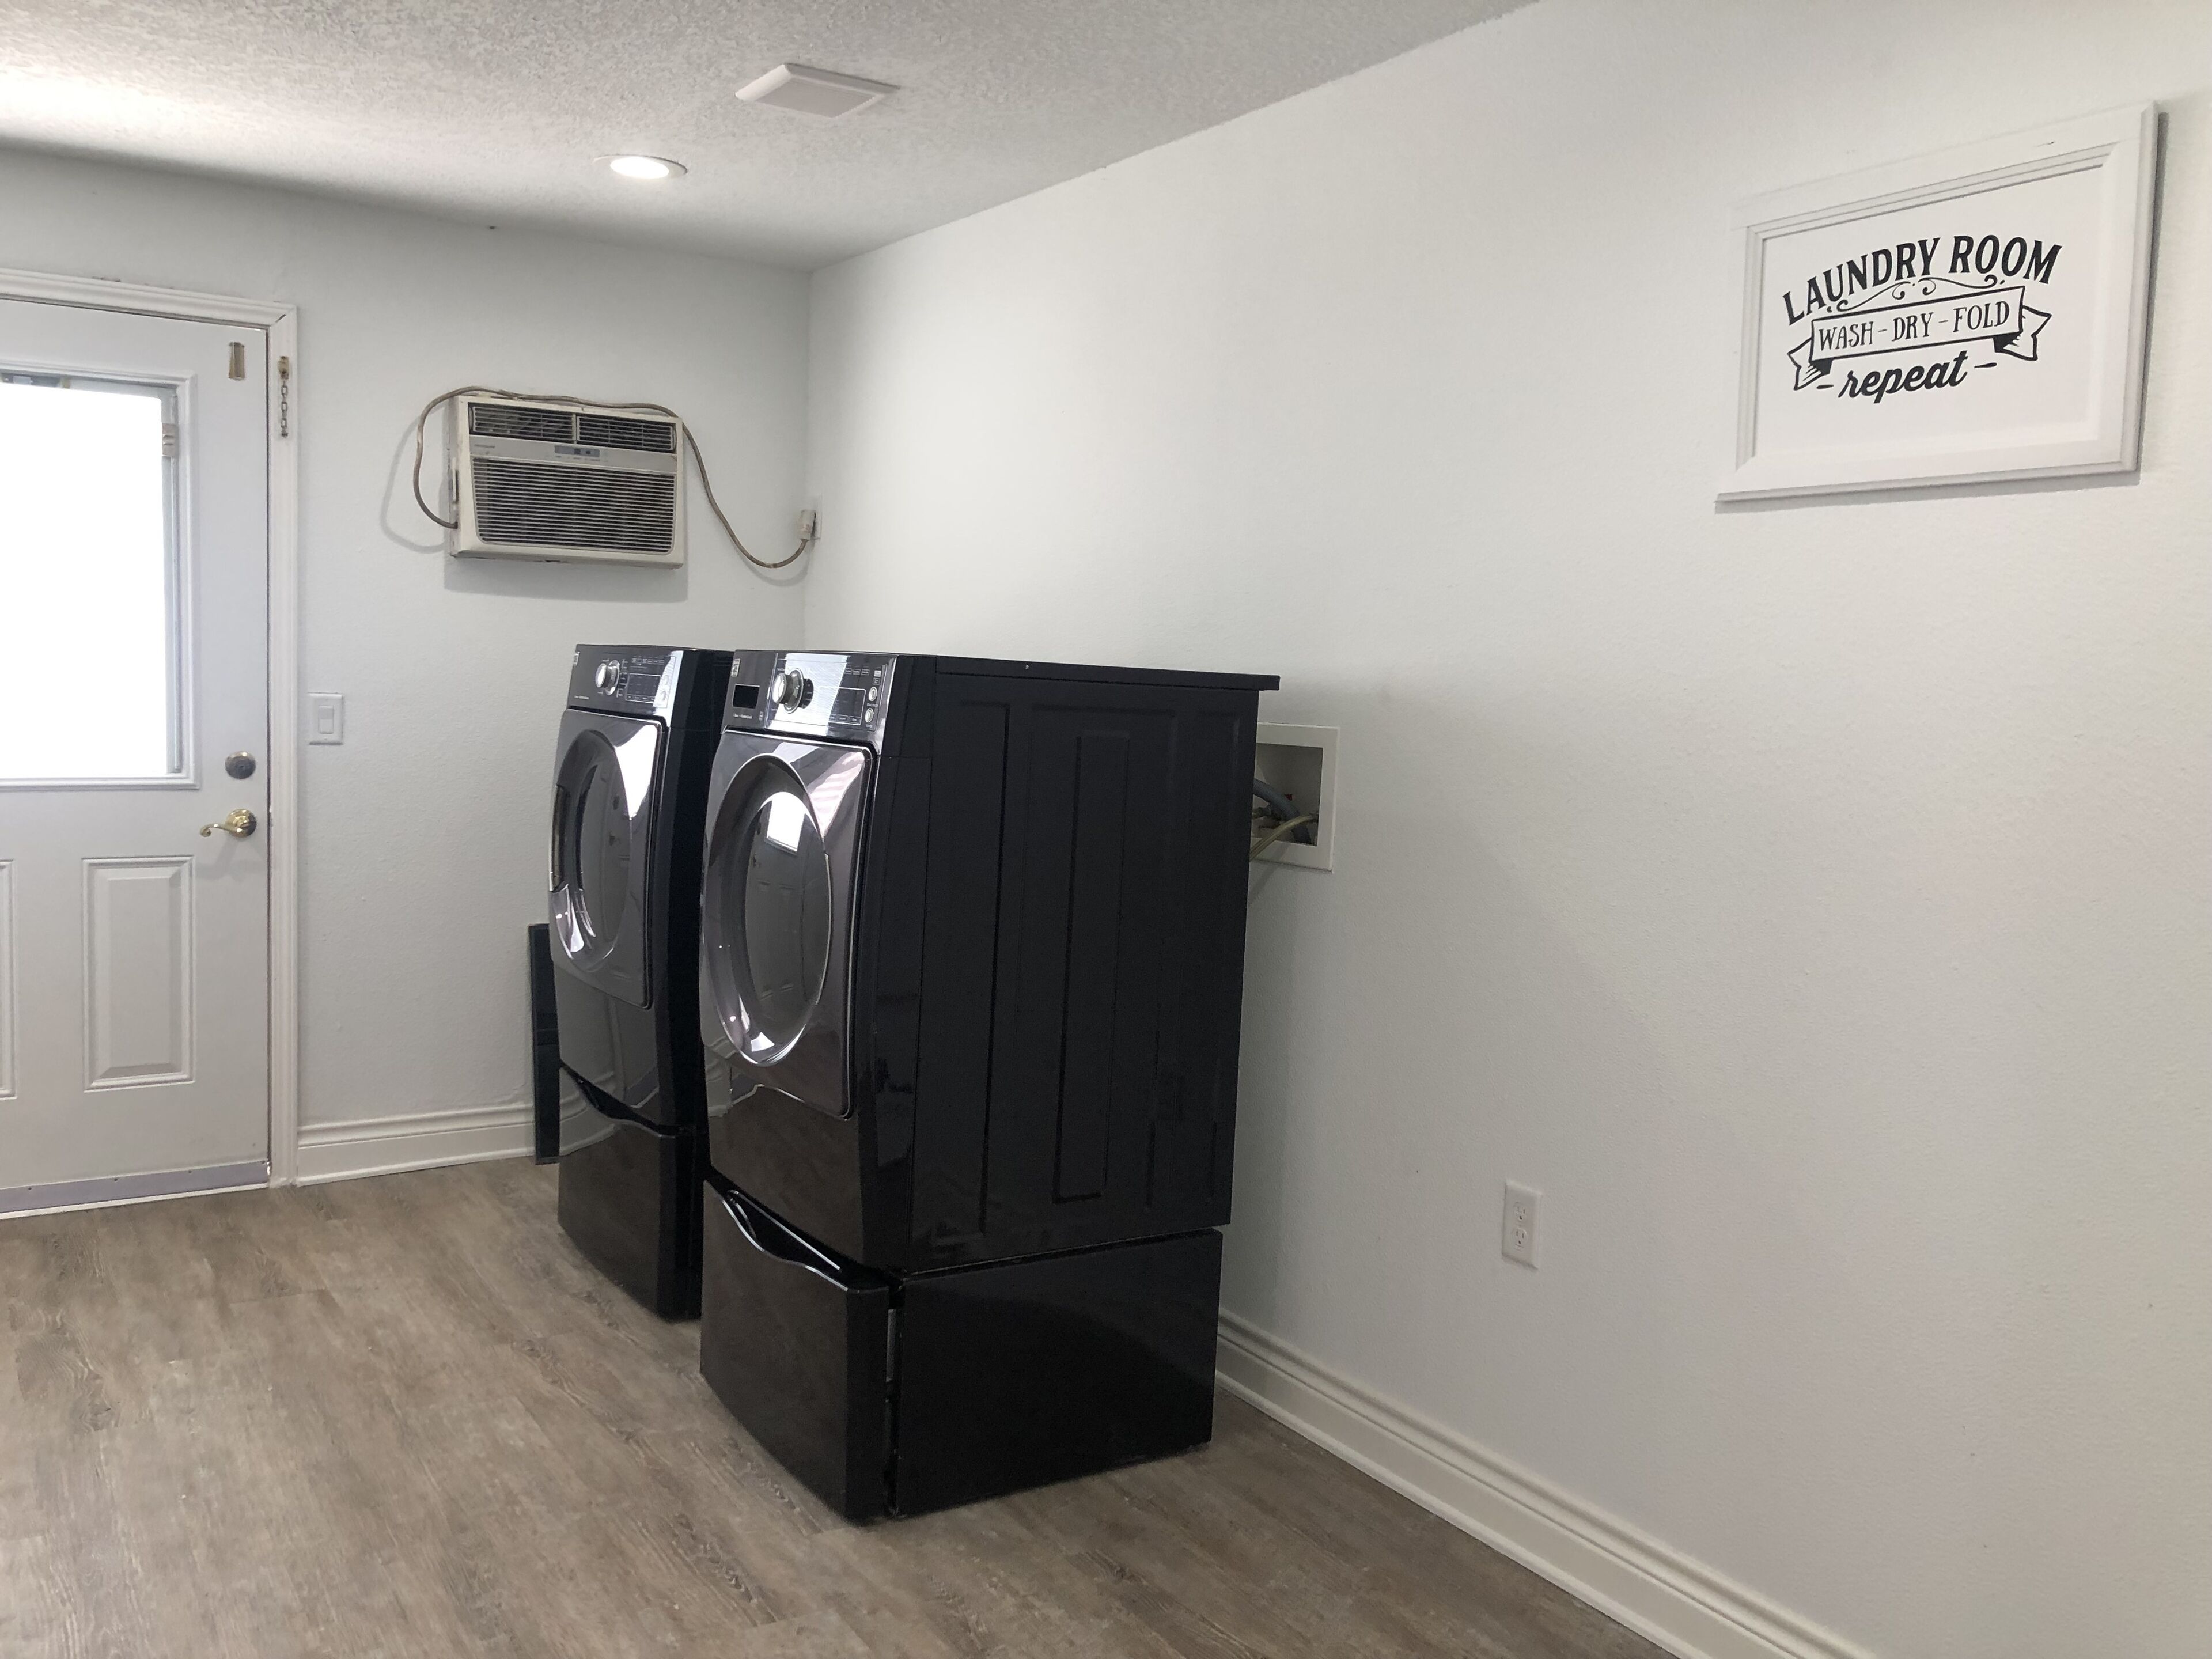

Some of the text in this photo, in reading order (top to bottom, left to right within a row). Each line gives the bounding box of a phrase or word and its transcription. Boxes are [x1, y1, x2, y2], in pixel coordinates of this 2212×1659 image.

[1782, 234, 2063, 325] LAUNDRY ROOM
[1819, 301, 2010, 351] WASH DRY FOLD
[1838, 350, 1968, 404] repeat
